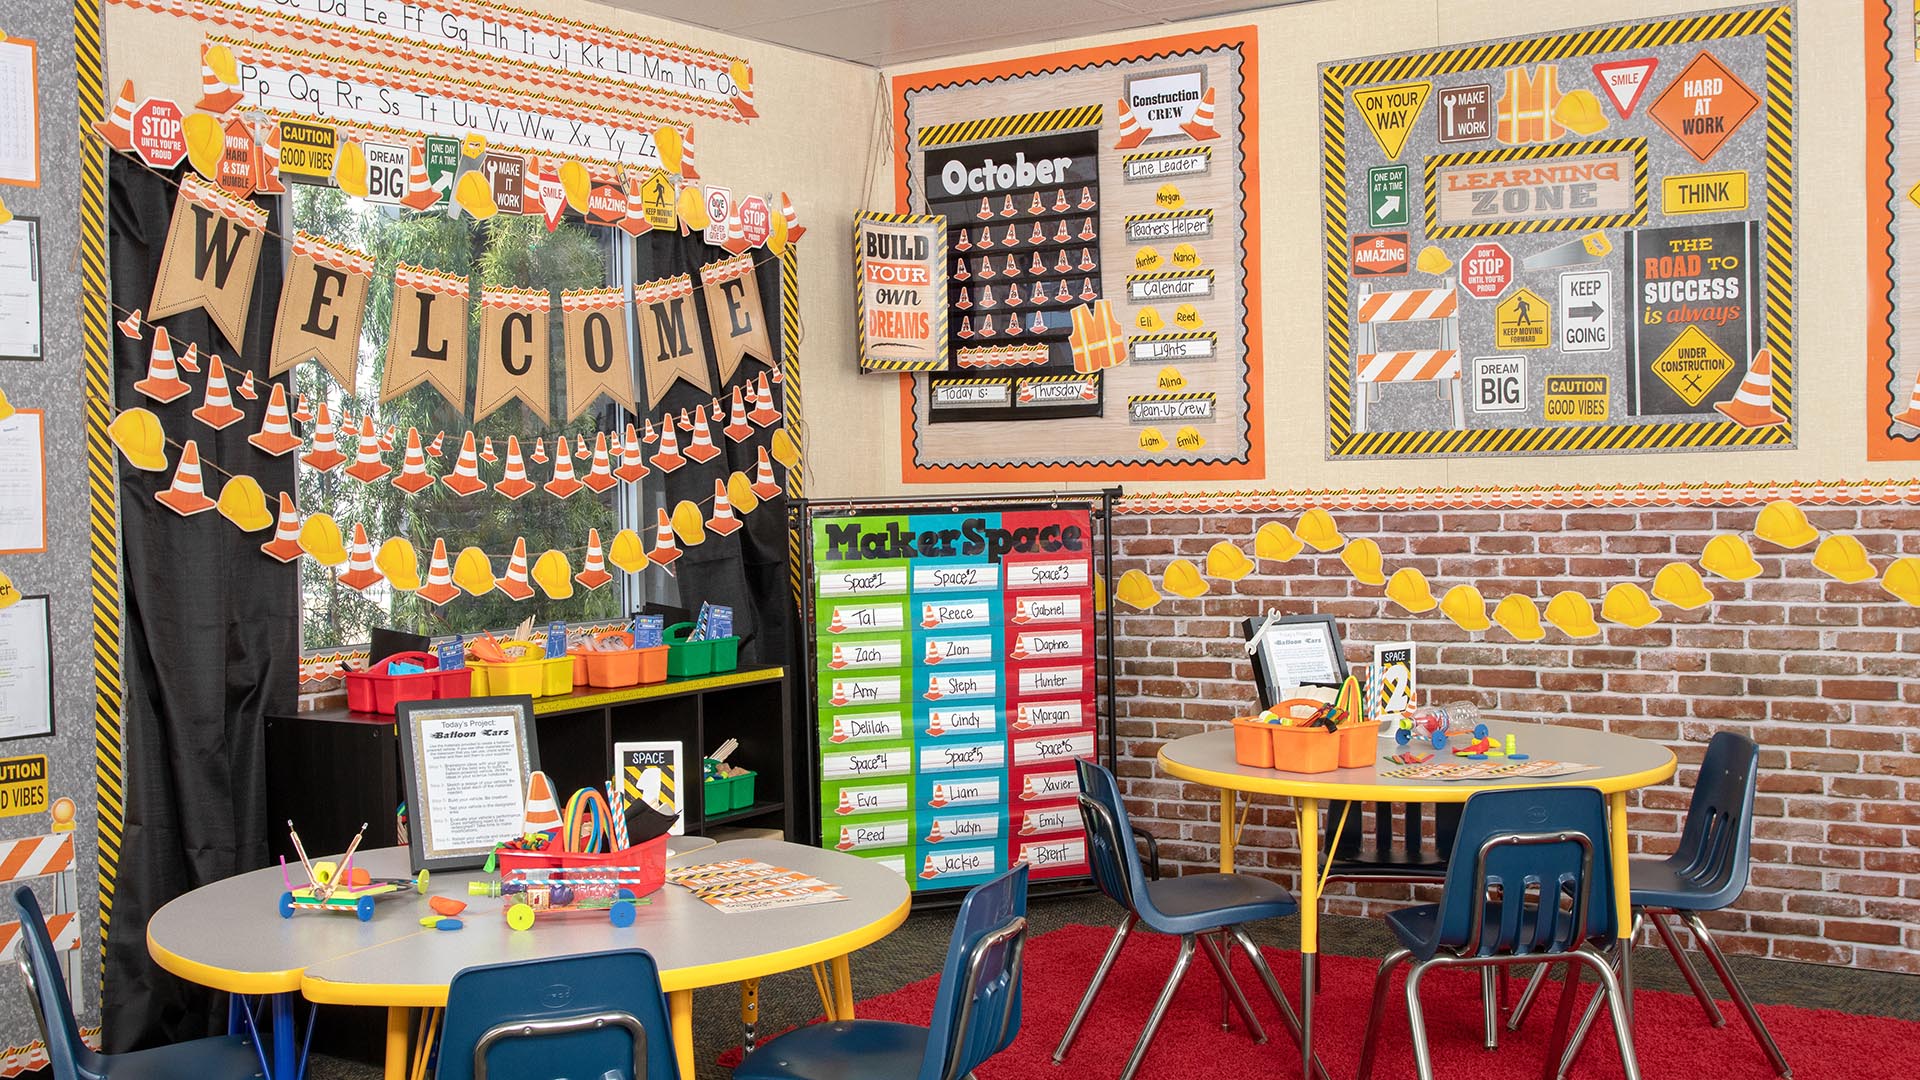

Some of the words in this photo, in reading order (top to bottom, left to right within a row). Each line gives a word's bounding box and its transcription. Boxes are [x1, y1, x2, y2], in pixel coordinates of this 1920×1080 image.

[364, 0, 387, 25] Ee
[404, 6, 425, 32] Ff
[441, 14, 468, 50] Gg
[482, 21, 508, 50] Hh
[523, 30, 534, 54] Ii
[549, 37, 568, 69] Jj
[582, 43, 604, 69] Kk
[616, 50, 631, 74] Ll
[644, 56, 674, 84] Mm
[685, 66, 706, 90] Nn
[717, 73, 738, 96] Oo
[1612, 72, 1639, 86] SMILE
[1684, 78, 1723, 98] HARD
[1132, 89, 1199, 108] Construction
[1366, 96, 1383, 111] ON
[1387, 92, 1418, 108] YOUR
[1458, 92, 1485, 106] MAKE
[152, 106, 171, 117] DON'T
[241, 66, 270, 106] Pp
[288, 74, 324, 116] Qq
[337, 81, 362, 109] Rr
[378, 89, 400, 116] Ss
[414, 94, 438, 122] Tt
[453, 101, 477, 128] Uu
[486, 107, 508, 134] Vv
[518, 112, 554, 140] Ww
[569, 122, 592, 148] Xx
[604, 128, 624, 159] Yy
[638, 133, 656, 158] Zz
[1148, 106, 1184, 120] CREW
[1467, 107, 1475, 120] IT
[1694, 98, 1712, 116] AT
[142, 116, 180, 139] STOP
[1376, 110, 1408, 130] WAY
[1458, 120, 1486, 135] WORK
[1682, 116, 1724, 136] WORK
[141, 137, 158, 147] UNTIL
[160, 138, 182, 151] YOU'RE
[225, 135, 250, 150] WORK
[284, 126, 332, 146] CAUTION
[150, 148, 172, 160] PROUD
[226, 148, 248, 162] HARD
[370, 150, 404, 166] DREAM
[431, 144, 443, 154] ONE
[444, 144, 456, 156] DAY
[280, 146, 306, 166] GOOD
[308, 151, 332, 171] VIBES
[444, 156, 456, 166] TIME
[230, 164, 250, 176] STAY
[499, 161, 520, 176] MAKE
[942, 152, 1072, 196] October
[1132, 162, 1154, 176] Line
[1159, 158, 1198, 173] Leader
[222, 175, 249, 189] HUMBLE
[370, 166, 404, 198] BIG
[506, 178, 512, 191] IT
[1374, 172, 1388, 182] ONE
[1389, 171, 1402, 181] DAY
[1448, 162, 1620, 191] LEARNING
[542, 186, 564, 200] SMILE
[1388, 182, 1403, 191] TIME
[1678, 182, 1730, 204] THINK
[497, 192, 520, 208] WORK
[589, 196, 626, 212] AMAZING
[1156, 192, 1180, 204] Morgan
[1472, 182, 1597, 216] ZONE
[646, 207, 656, 216] KEEP
[744, 210, 766, 227] STOP
[1129, 222, 1170, 237] Teacher's
[1172, 219, 1206, 235] Helper
[866, 231, 930, 260] BUILD
[1376, 240, 1384, 248] BE
[1669, 238, 1713, 252] THE
[1136, 254, 1158, 268] Hunter
[1173, 252, 1196, 264] Nancy
[1356, 248, 1404, 262] AMAZING
[1478, 249, 1495, 258] DON'T
[868, 264, 928, 283] YOUR
[1468, 258, 1504, 276] STOP
[1644, 254, 1702, 280] ROAD
[1707, 256, 1739, 270] TO
[1468, 276, 1485, 284] UNTIL
[1485, 274, 1505, 283] YOU'RE
[1144, 280, 1194, 296] Calendar
[1476, 284, 1496, 292] PROUD
[1570, 280, 1601, 296] KEEP
[1644, 276, 1739, 304] SUCCESS
[876, 288, 922, 306] own
[1140, 316, 1152, 328] Eli
[1176, 312, 1196, 322] Reed
[1644, 306, 1662, 324] is
[1666, 304, 1741, 327] always
[869, 310, 930, 340] DREAMS
[1503, 328, 1518, 336] KEEP
[1519, 326, 1543, 335] MOVING
[1566, 327, 1606, 344] GOING
[1153, 342, 1186, 358] Lights
[1678, 347, 1707, 359] UNDER
[1481, 364, 1519, 374] DREAM
[1661, 359, 1725, 372] CONSTRUCTION
[1160, 378, 1182, 388] Alina
[1481, 376, 1520, 404] BIG
[1550, 381, 1603, 392] CAUTION
[941, 388, 973, 401] Today
[1032, 384, 1082, 400] Thursday
[1178, 401, 1207, 416] Crew
[1548, 400, 1575, 415] GOOD
[1578, 399, 1605, 415] VIBES
[1140, 437, 1160, 447] Liam
[1176, 434, 1200, 448] Emily
[825, 518, 1082, 564] MakerSpace
[852, 608, 876, 626] Tal
[938, 606, 974, 624] Reece
[1030, 601, 1065, 618] Gabriel
[946, 642, 970, 656] Zion
[1034, 637, 1070, 654] Daphne
[855, 647, 882, 663] Zach
[1384, 650, 1406, 663] SPACE
[948, 678, 977, 694] Steph
[1034, 673, 1068, 688] Hunter
[852, 683, 878, 700] Amy
[1383, 664, 1410, 714] 2
[441, 720, 468, 729] Today's
[470, 719, 496, 729] Project:
[951, 713, 980, 729] Cindy
[1031, 708, 1070, 725] Morgan
[430, 731, 476, 739] Balloon
[482, 729, 509, 737] Cars
[850, 720, 890, 736] Delilah
[632, 752, 665, 764] SPACE
[949, 785, 980, 800] Liam
[1042, 777, 1075, 793] Xavier
[12, 786, 44, 808] VIBES
[857, 792, 878, 808] Eva
[950, 821, 982, 836] Jadyn
[1038, 814, 1065, 828] Emily
[857, 827, 886, 844] Reed
[1033, 846, 1070, 864] Brent
[936, 854, 980, 873] Jackie
